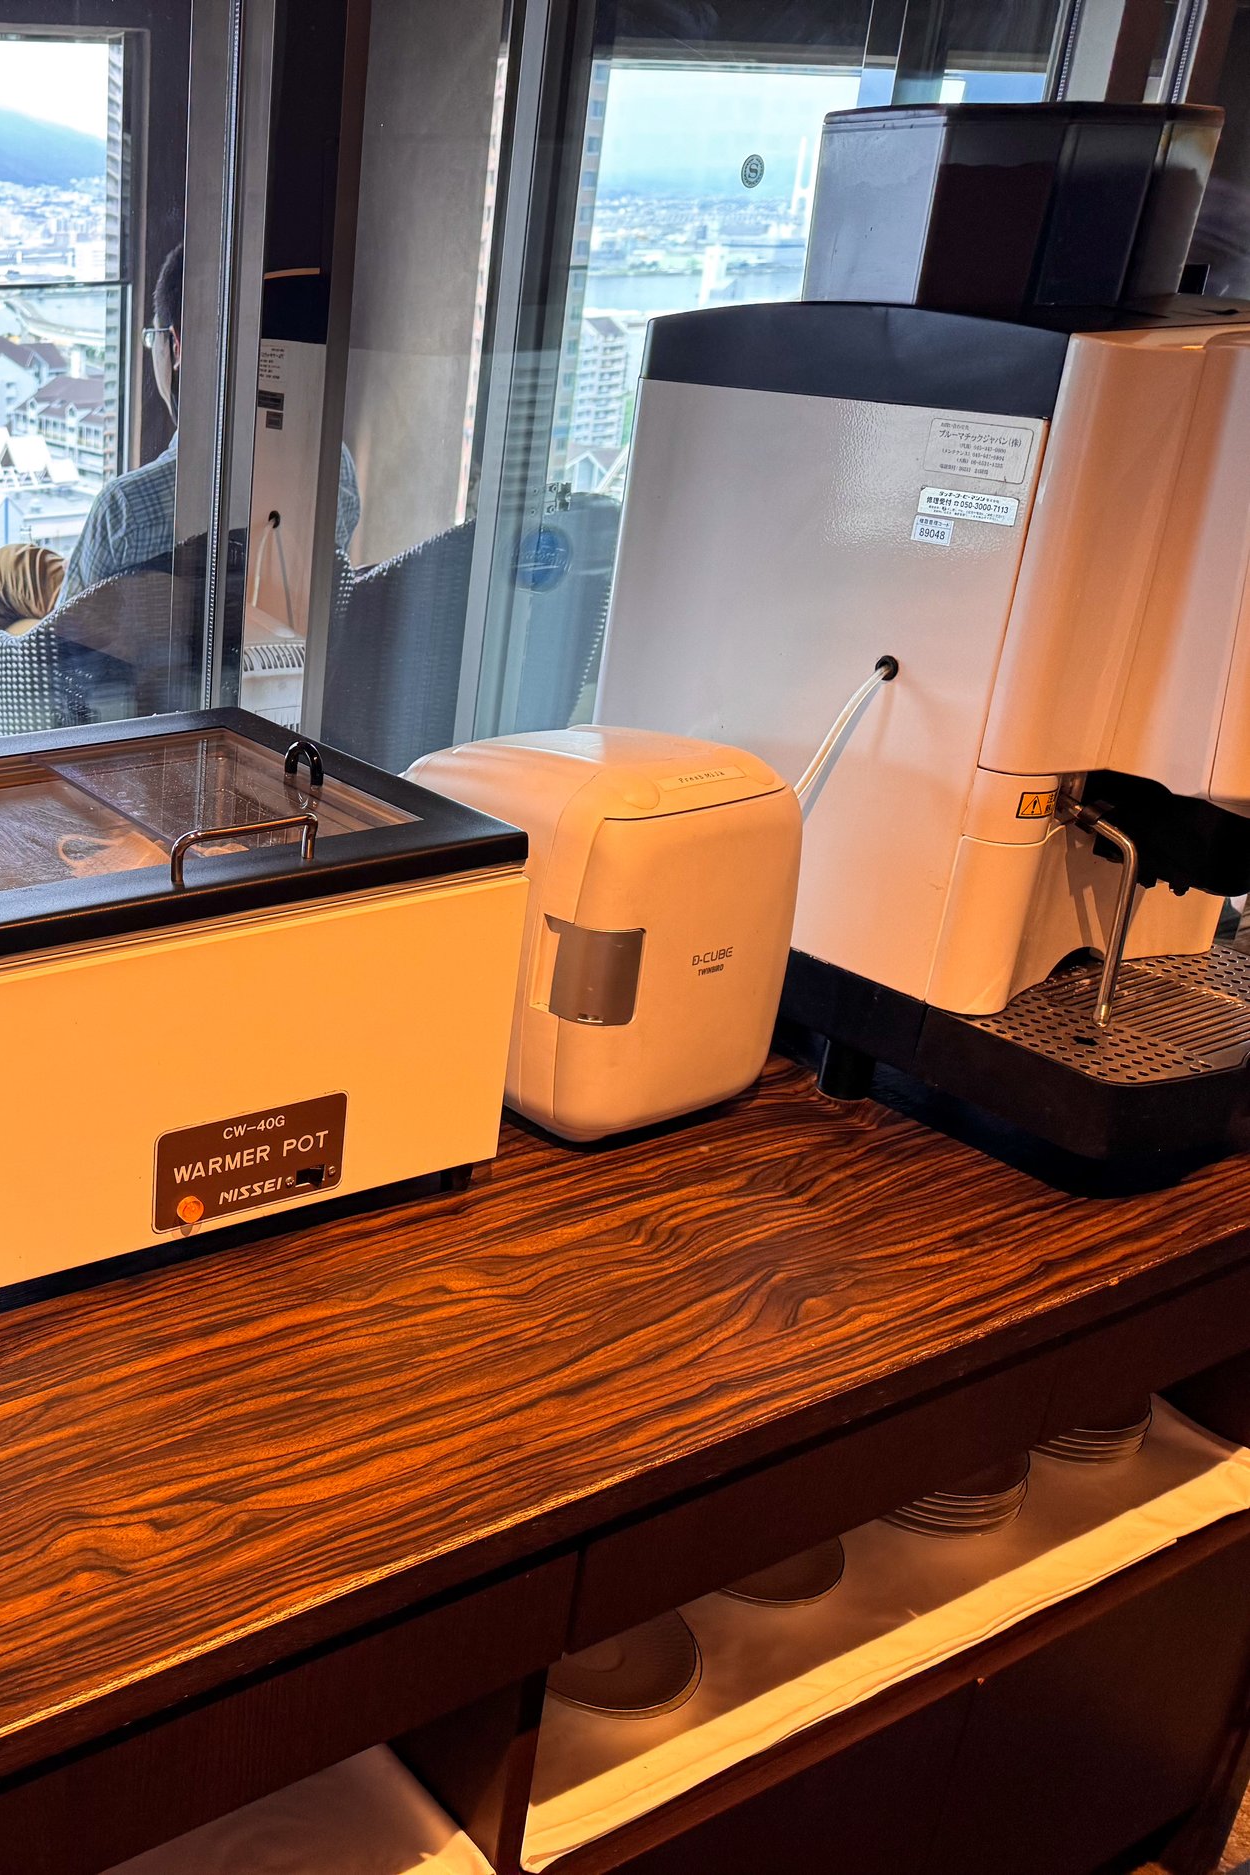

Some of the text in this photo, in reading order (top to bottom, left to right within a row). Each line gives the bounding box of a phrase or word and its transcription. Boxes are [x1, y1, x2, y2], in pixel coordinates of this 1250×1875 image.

[960, 501, 1009, 514] 050-3000-7113
[918, 527, 946, 540] 89048
[691, 946, 733, 966] D-CUBE
[223, 1115, 286, 1139] CW-40G
[173, 1130, 329, 1184] WARMER POT
[218, 1176, 283, 1205] NISSEI
